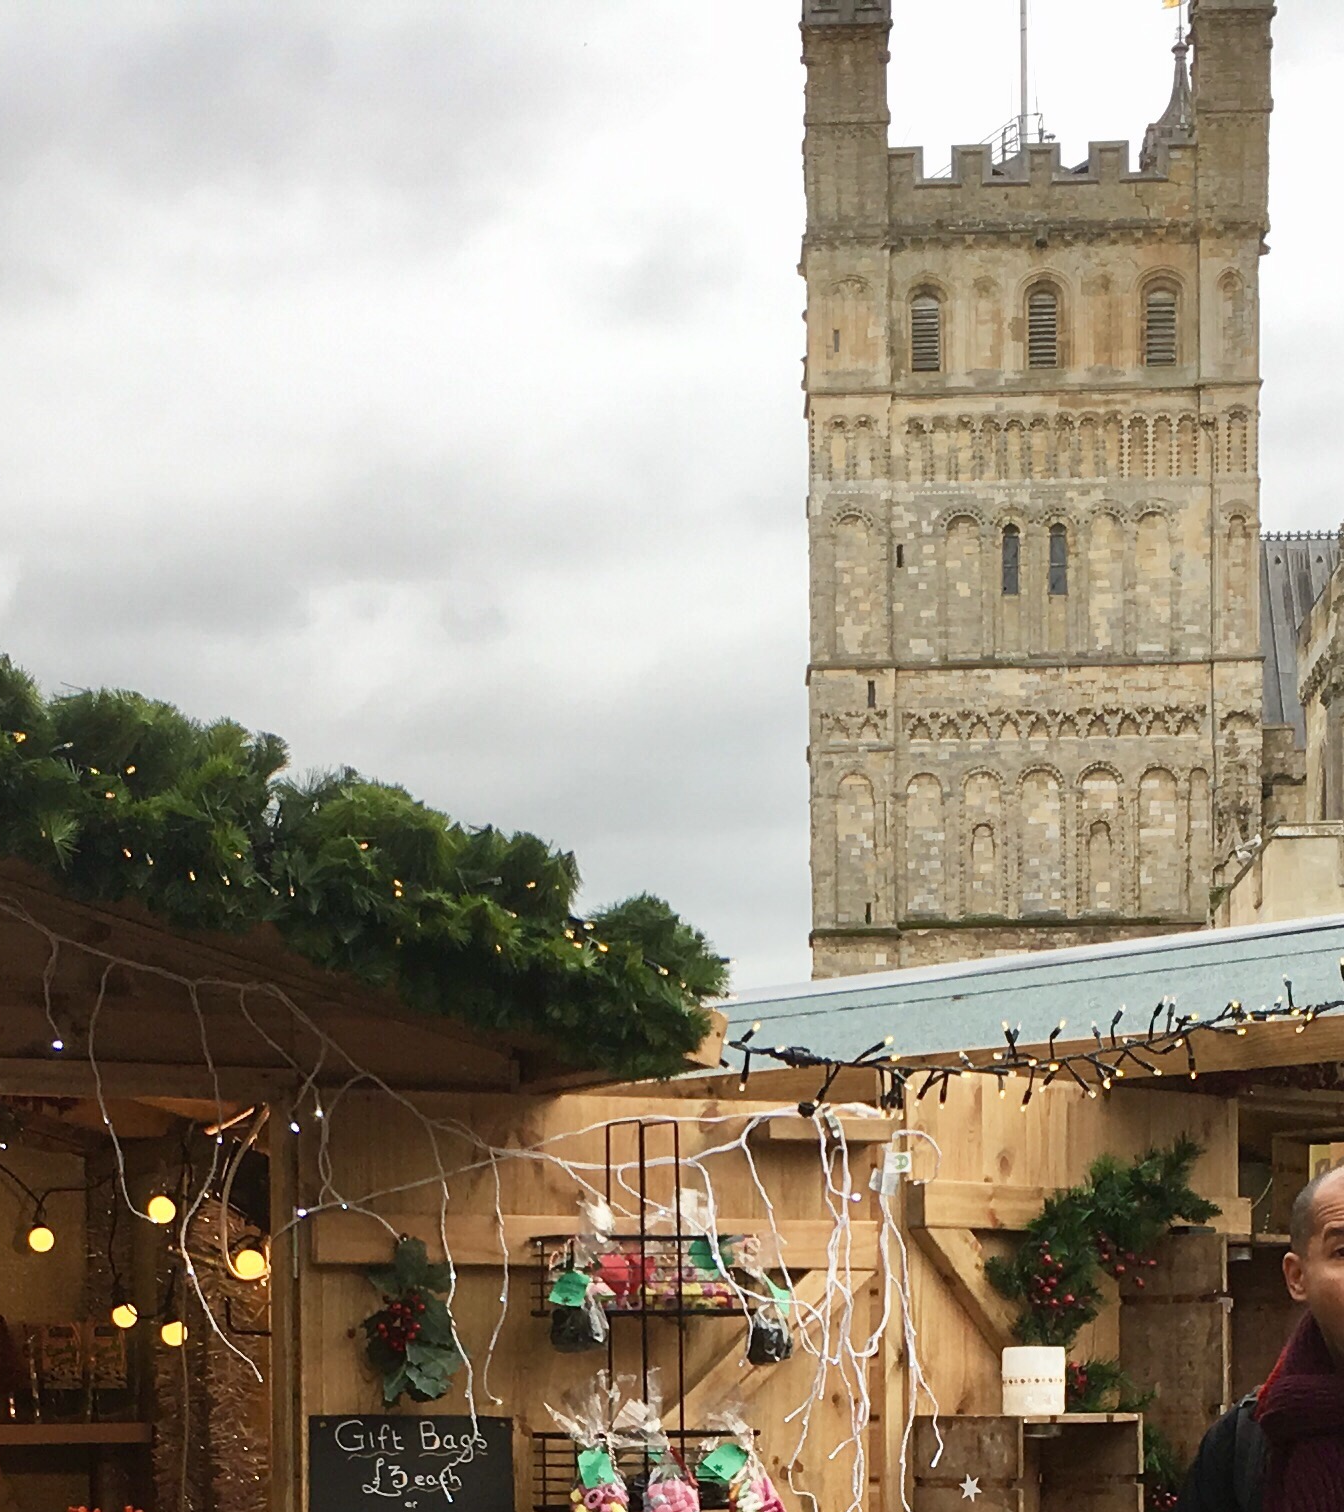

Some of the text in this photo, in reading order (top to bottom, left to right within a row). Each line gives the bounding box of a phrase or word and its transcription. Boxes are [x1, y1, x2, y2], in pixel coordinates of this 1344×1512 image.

[335, 1420, 488, 1463] Gift Bags
[362, 1458, 462, 1498] £3 each
[404, 1501, 418, 1509] or
